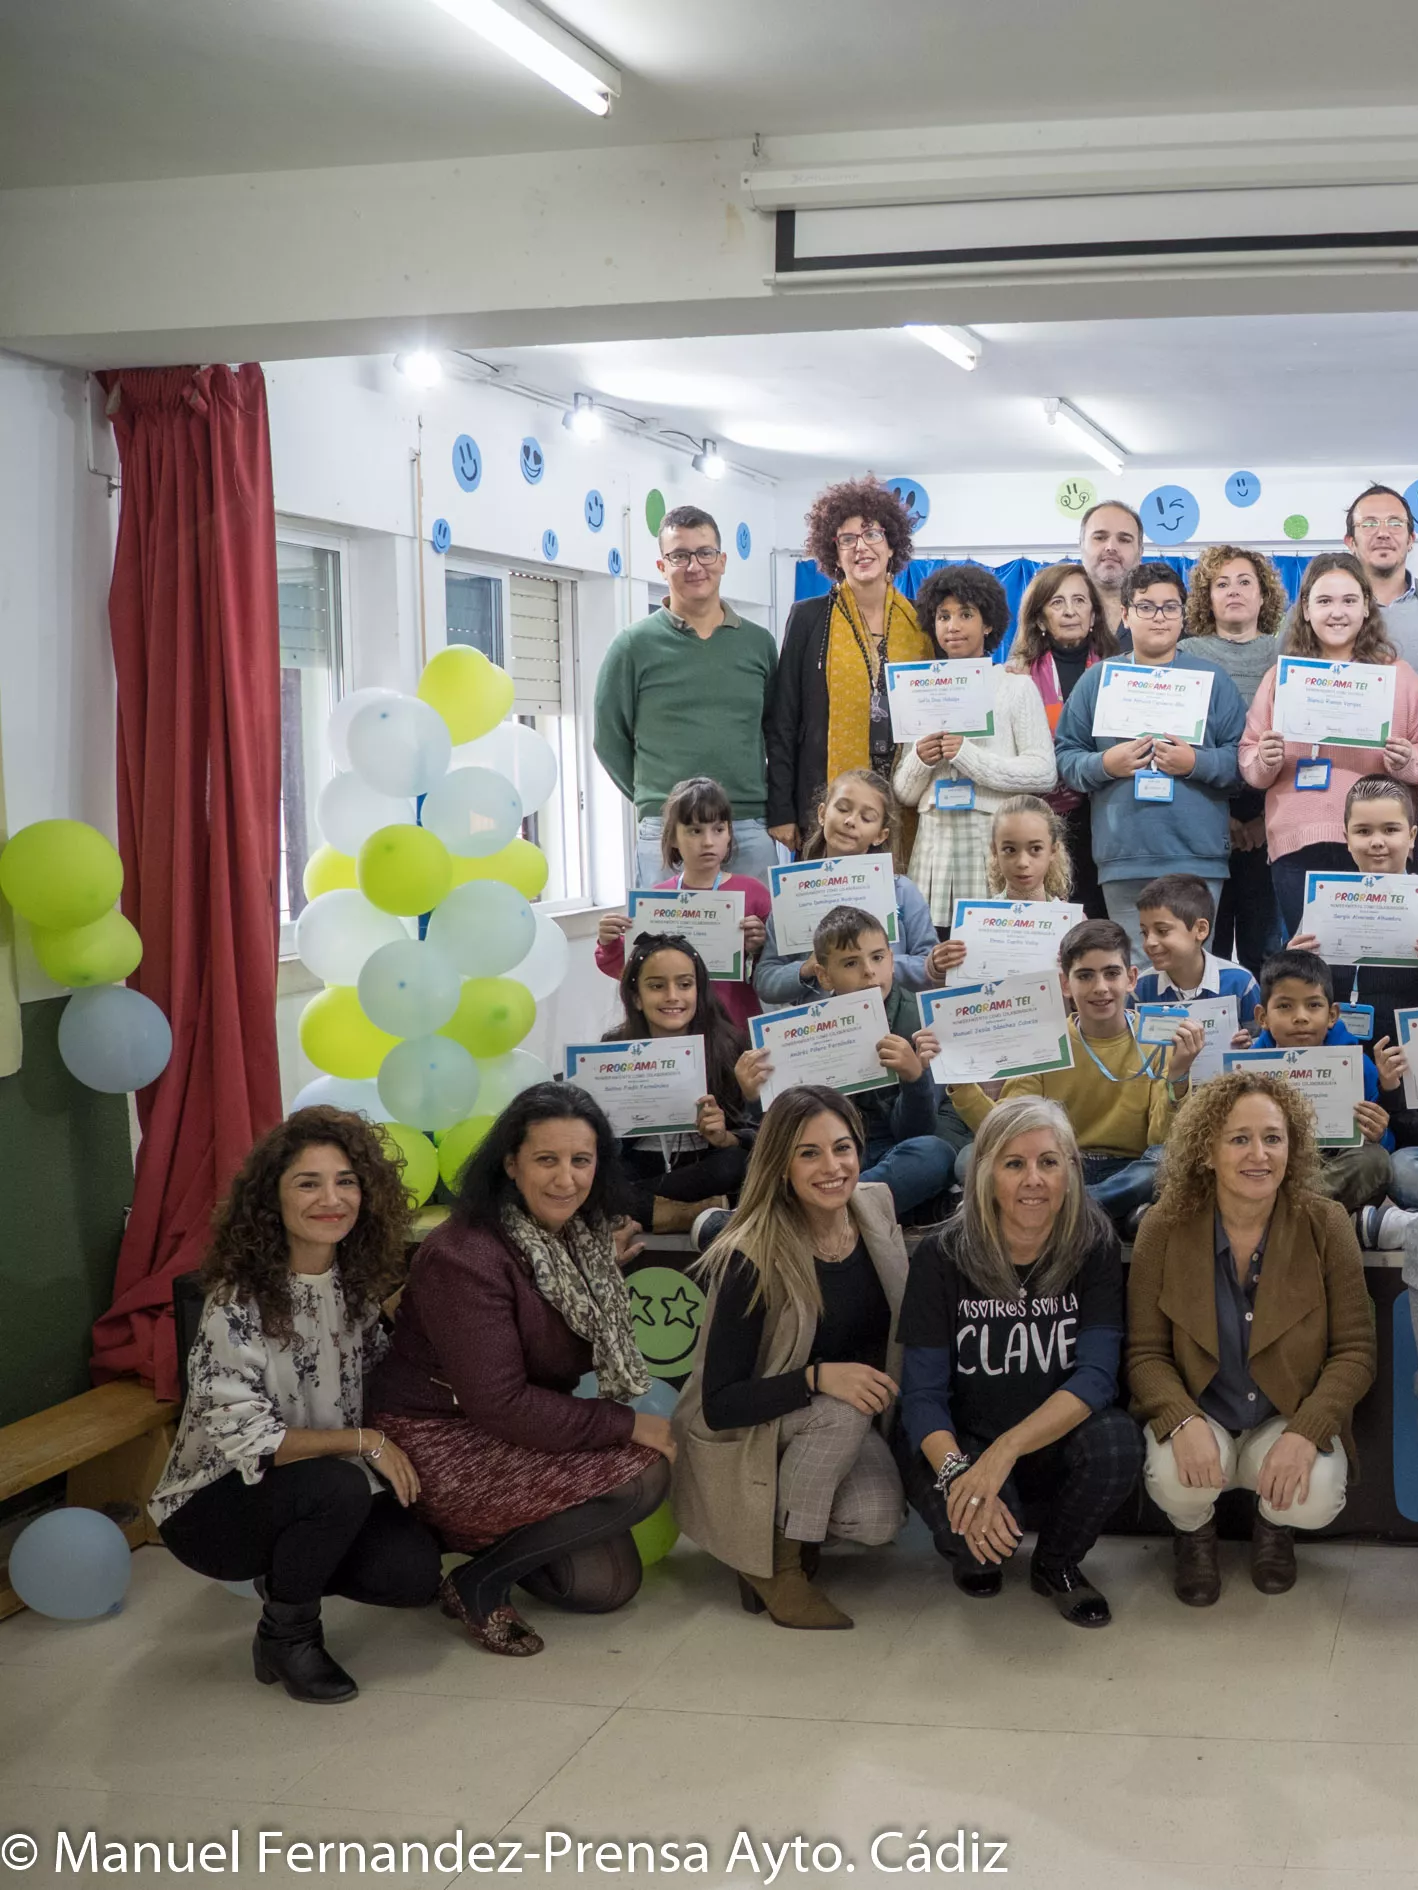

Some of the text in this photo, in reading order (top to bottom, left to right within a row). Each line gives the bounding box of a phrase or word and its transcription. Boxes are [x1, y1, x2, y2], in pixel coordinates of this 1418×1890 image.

[910, 676, 967, 687] PROGRAMA TEI
[1127, 680, 1172, 690] PROGRAMA
[1304, 677, 1368, 690] PROGRAMA TEI
[798, 875, 865, 890] PROGRAMA TEI
[1335, 892, 1405, 904] PROGRAMA TEI
[653, 908, 717, 919] PROGRAMA TEI
[983, 918, 1052, 929] PROGRAMA TEI
[955, 996, 1031, 1017] PROGRAMA TEI
[784, 1015, 855, 1039] PROGRAMA TEI
[1202, 1019, 1215, 1028] TEI
[599, 1059, 676, 1073] PROGRAMA TEI
[1316, 1069, 1332, 1078] TEI
[1062, 1292, 1079, 1313] LA
[956, 1318, 1077, 1376] CLAVE
